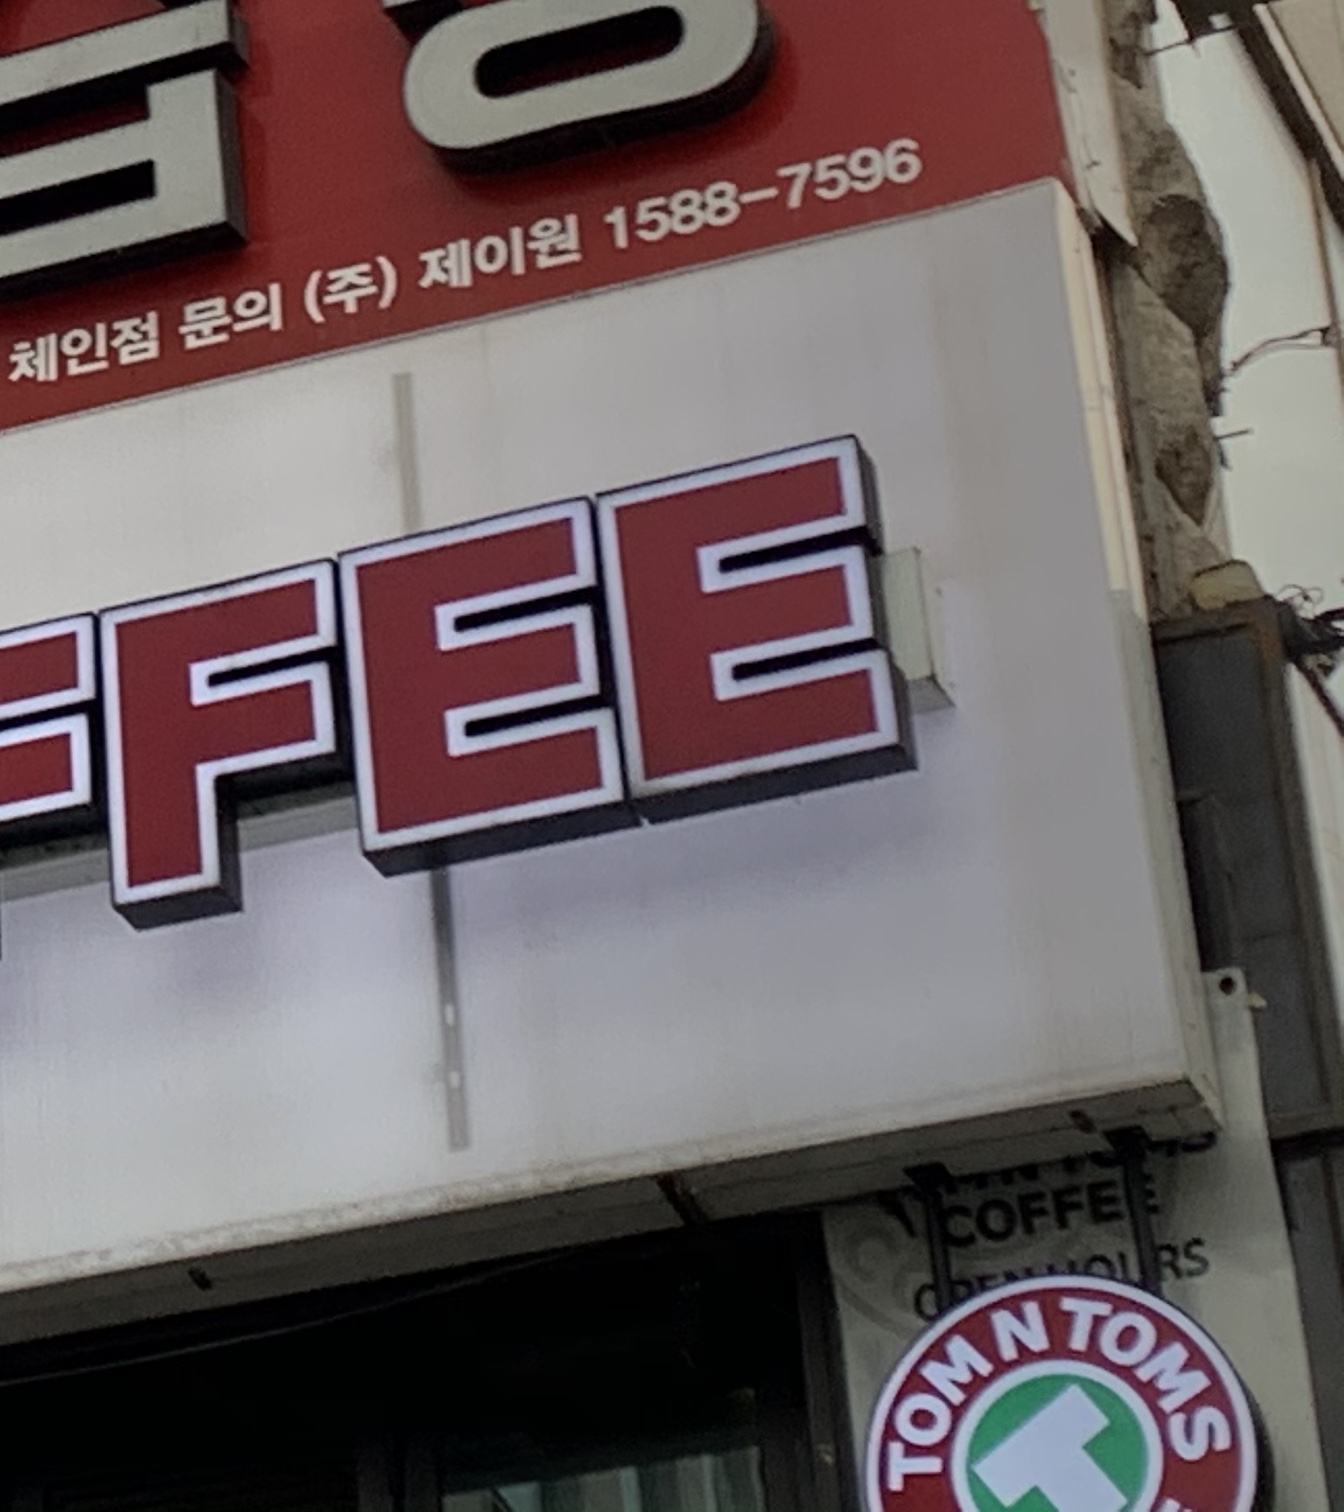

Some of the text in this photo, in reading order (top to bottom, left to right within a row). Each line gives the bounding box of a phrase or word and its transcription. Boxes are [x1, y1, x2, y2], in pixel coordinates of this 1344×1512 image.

[6, 138, 922, 386] 체인점 문의 (주) 제이원 1588-7596
[888, 1296, 1232, 1492] TOM N TOMS
